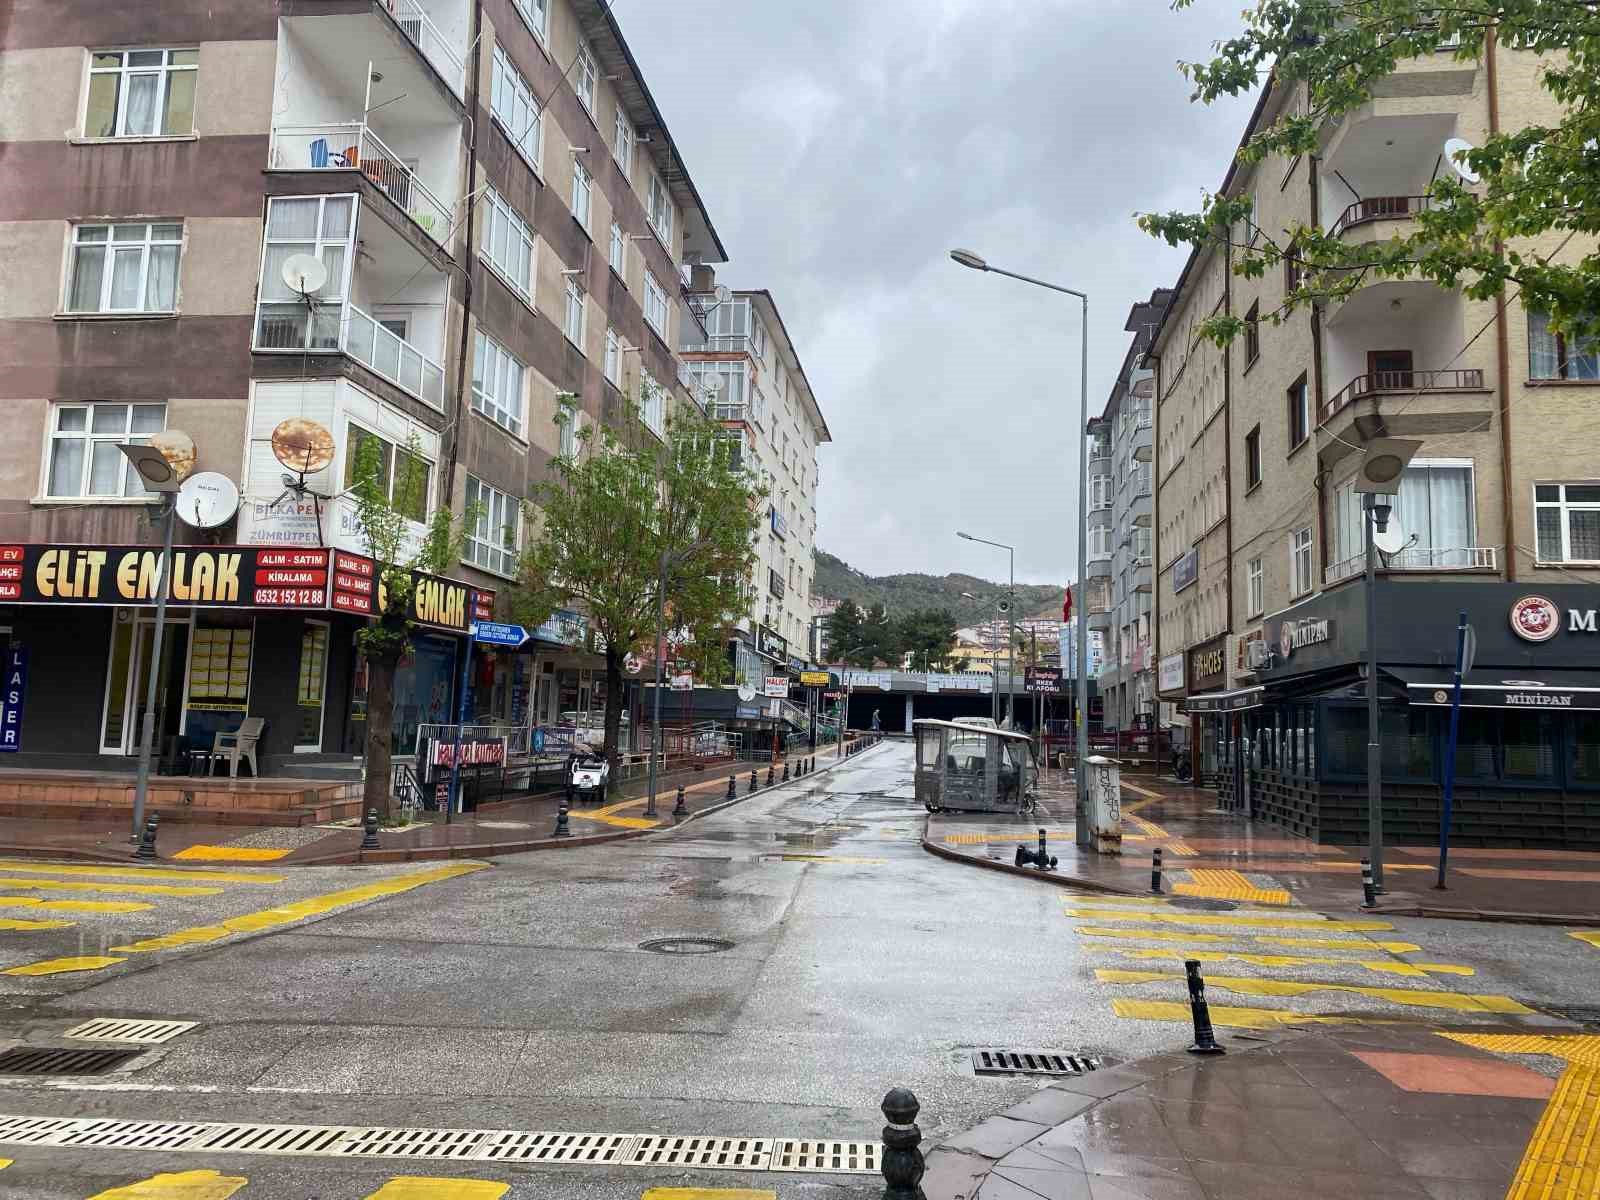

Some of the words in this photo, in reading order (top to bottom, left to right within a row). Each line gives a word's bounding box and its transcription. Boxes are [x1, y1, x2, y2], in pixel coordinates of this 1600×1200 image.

[262, 555, 286, 564] ALIM
[293, 555, 323, 565] SATIM
[117, 551, 241, 602] EMLAK
[268, 570, 313, 583] KİRALAMA
[256, 589, 278, 603] 0532
[280, 590, 296, 603] 152
[298, 590, 310, 603] 12
[312, 590, 323, 604] 88
[416, 579, 466, 627] EMLAK
[1505, 692, 1572, 706] MİNİPAN
